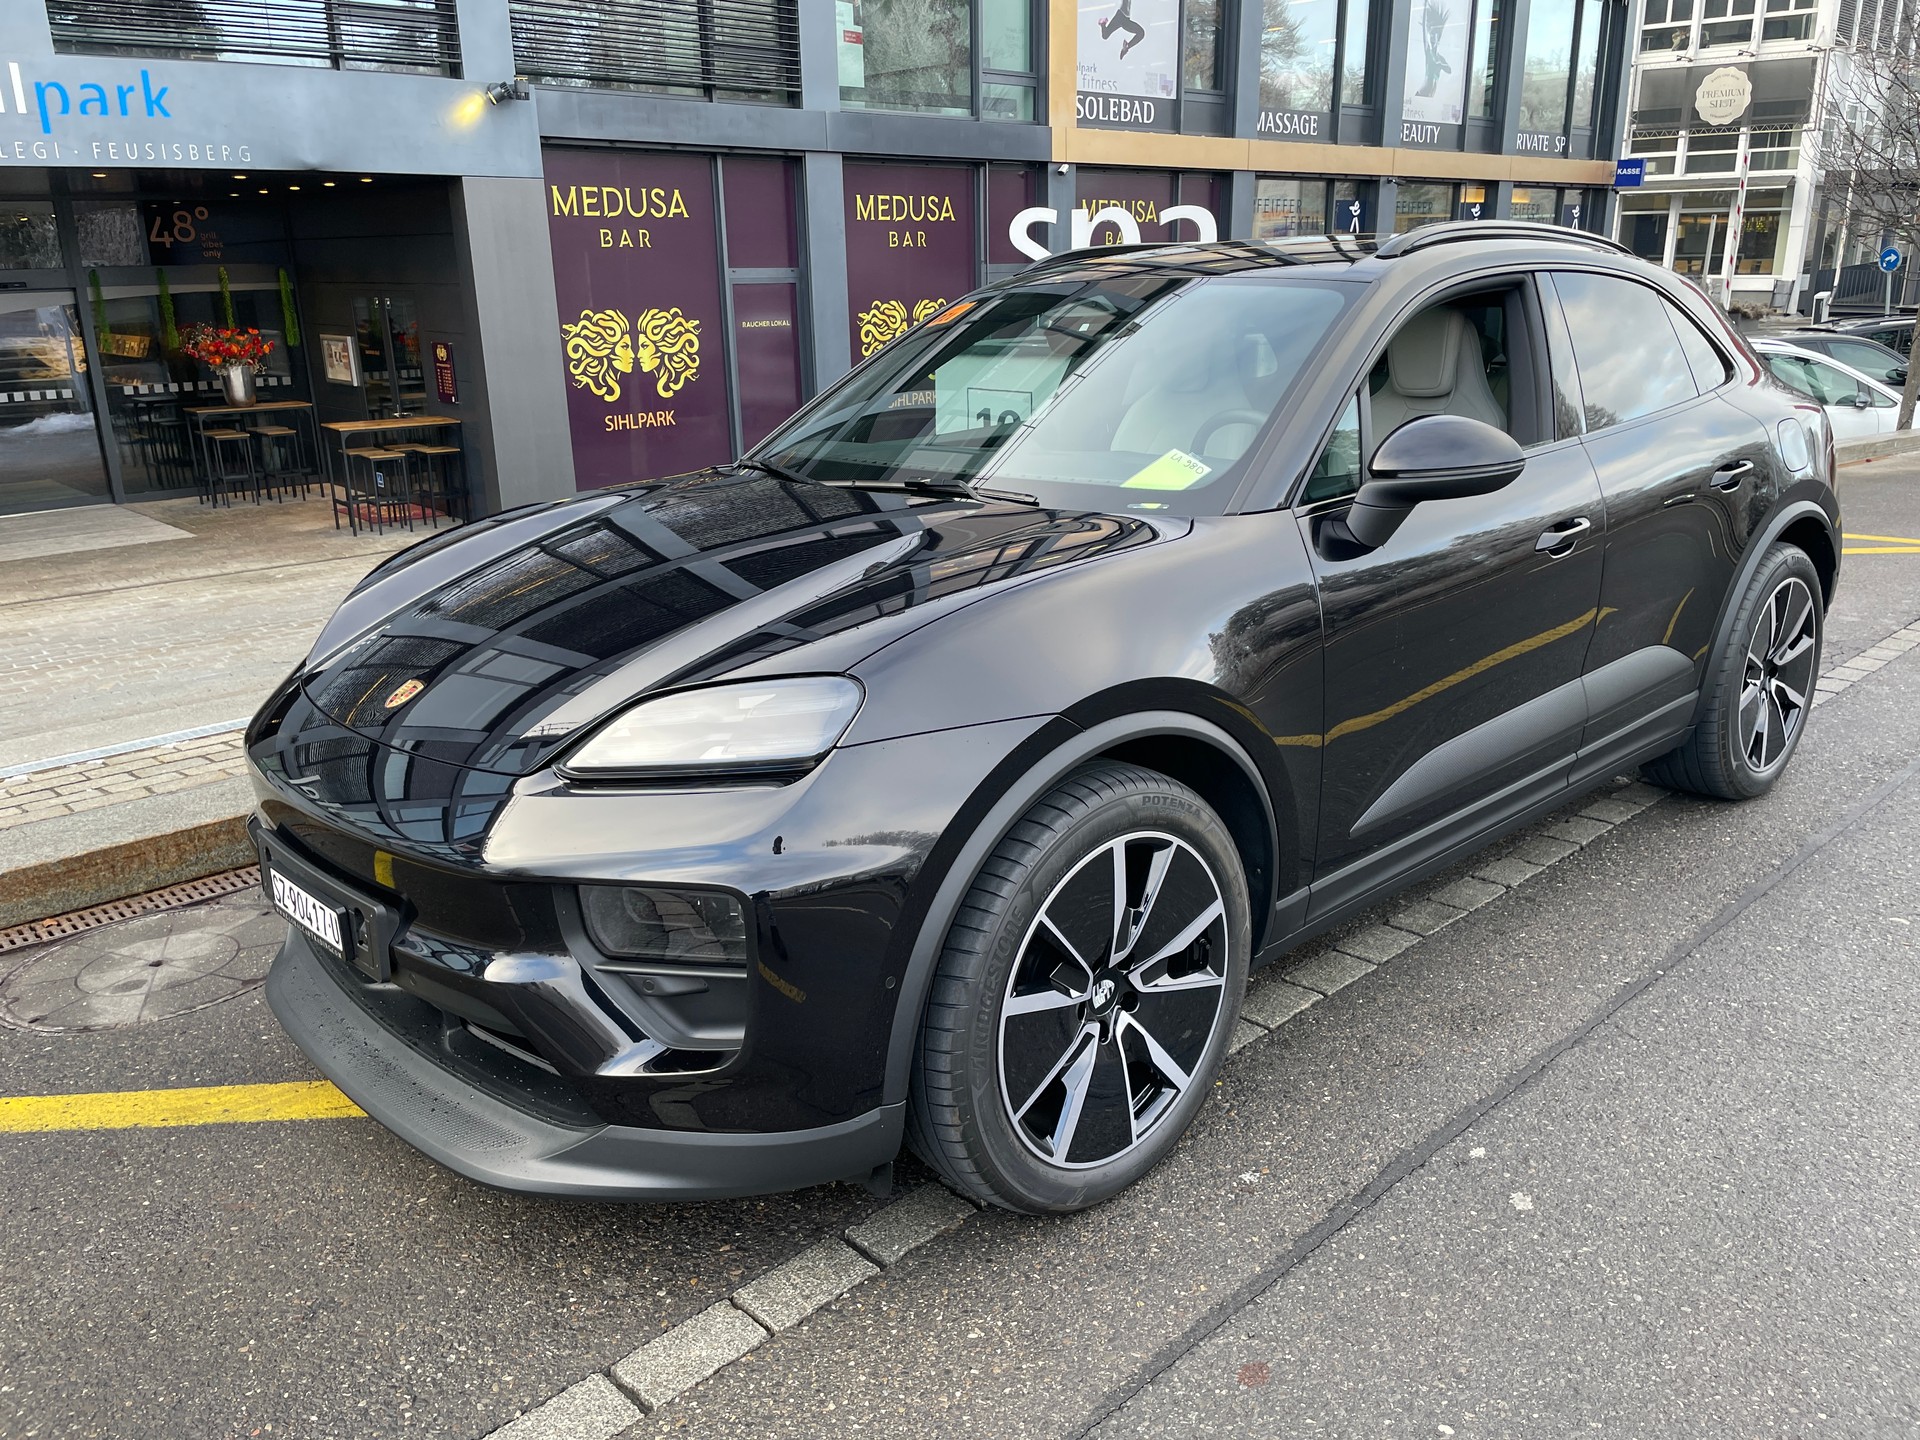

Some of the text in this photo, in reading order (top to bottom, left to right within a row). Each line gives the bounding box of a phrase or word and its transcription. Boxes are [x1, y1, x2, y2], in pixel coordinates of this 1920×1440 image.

[1082, 74, 1118, 91] fitness
[1702, 88, 1745, 98] PREMIUM
[0, 62, 171, 134] lpark
[1076, 95, 1155, 124] SOLEBAD
[92, 142, 252, 163] FEUSISBERG
[1554, 136, 1573, 153] SP
[550, 185, 690, 219] MEDUSA
[855, 194, 957, 222] MEDUSA
[599, 228, 652, 248] BAR
[889, 231, 928, 248] BAR
[604, 410, 676, 432] SIHLPARK
[1142, 795, 1202, 820] POTENZA
